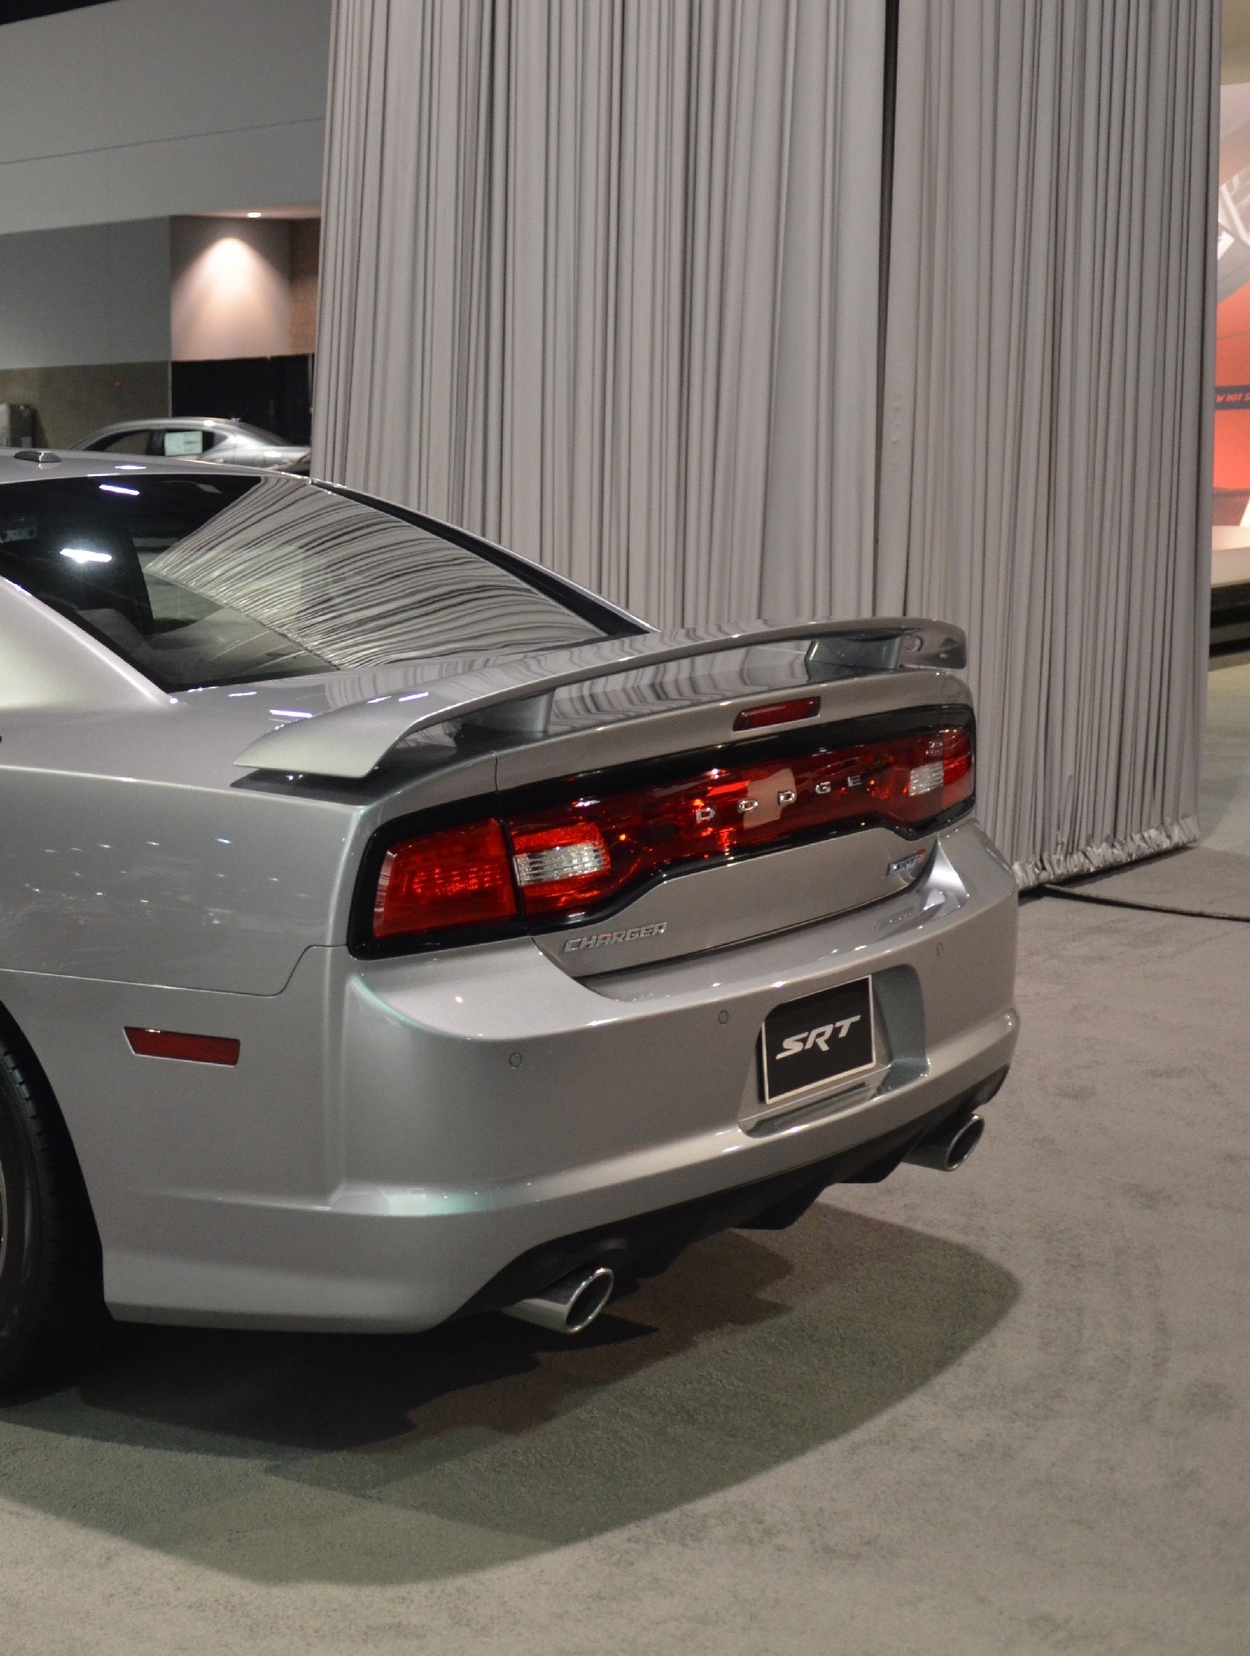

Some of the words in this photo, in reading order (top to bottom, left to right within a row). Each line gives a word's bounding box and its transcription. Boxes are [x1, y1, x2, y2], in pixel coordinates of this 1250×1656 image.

[695, 774, 861, 823] DODGE
[562, 921, 668, 953] CHARGER
[775, 1014, 862, 1060] SRT
